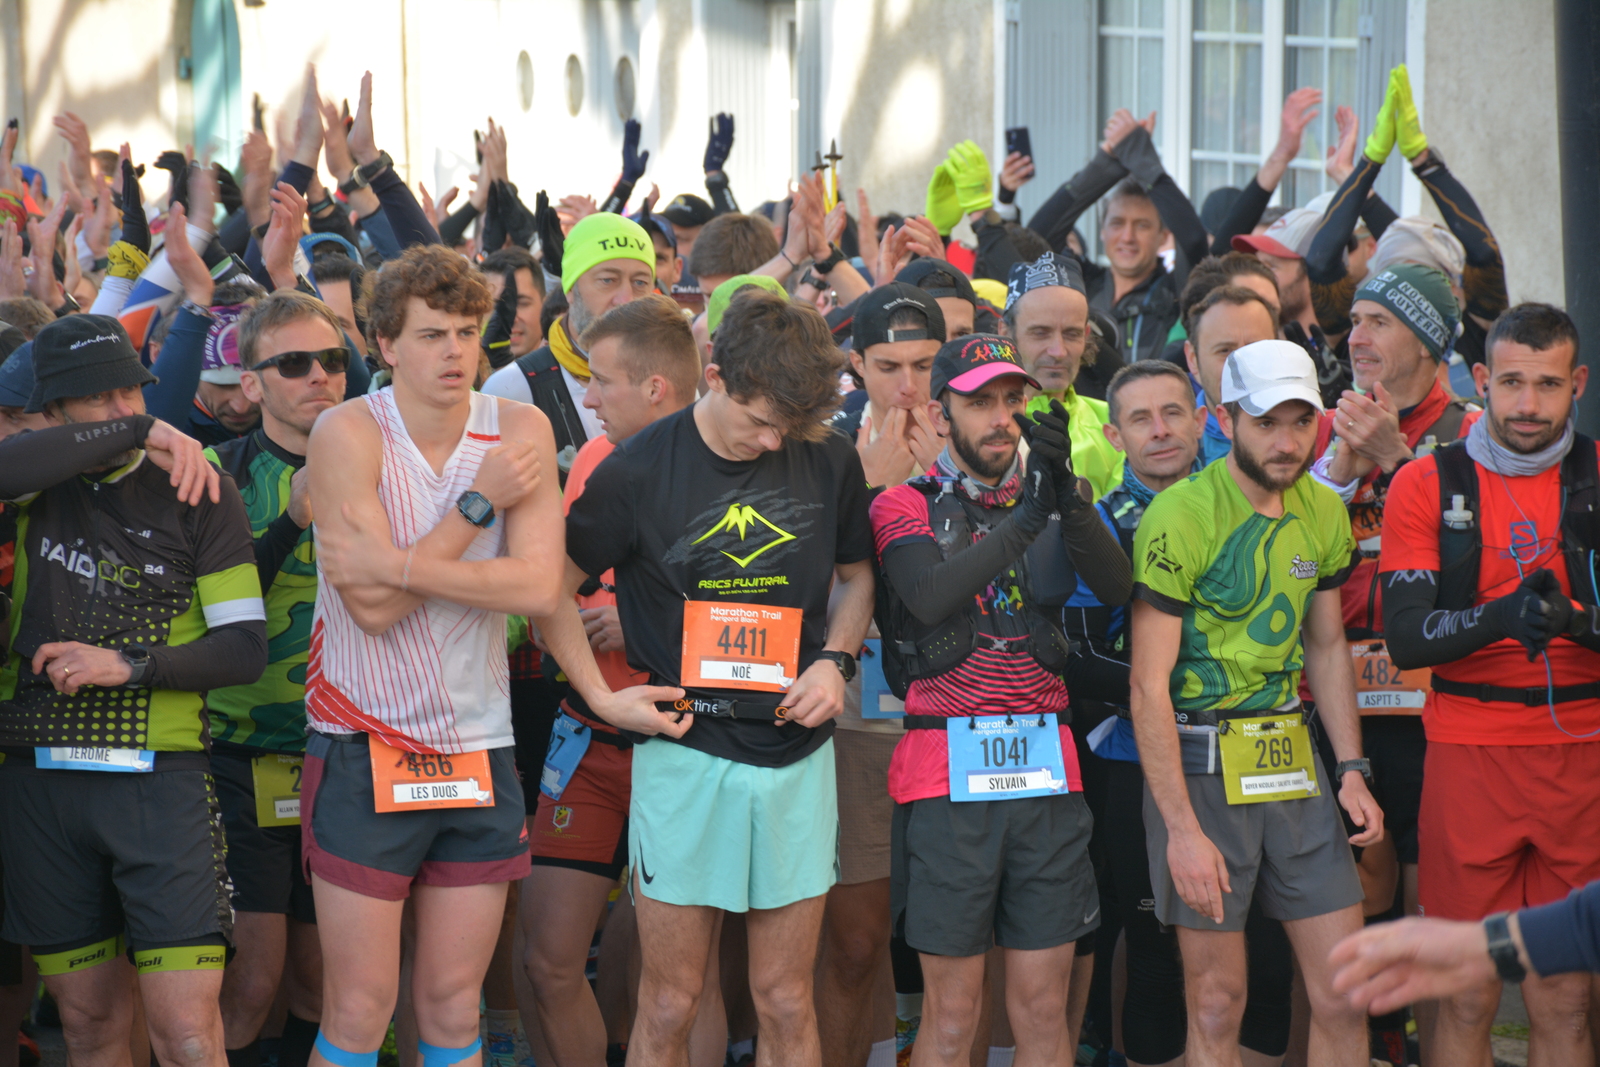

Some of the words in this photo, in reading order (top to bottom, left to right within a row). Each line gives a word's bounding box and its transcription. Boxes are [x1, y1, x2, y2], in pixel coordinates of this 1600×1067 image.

[144, 564, 165, 576] 24
[698, 579, 732, 589] ASICS
[732, 575, 790, 588] FUJITRAIL
[710, 606, 759, 617] Marathon
[761, 610, 782, 620] Trail
[717, 625, 767, 657] 4411
[731, 664, 752, 679] NOÉ
[1362, 658, 1403, 685] 482
[1364, 694, 1392, 706] ASPTT
[1395, 694, 1402, 706] 5
[980, 736, 1028, 767] 1041
[1255, 736, 1293, 769] 269
[989, 776, 1027, 791] SYLVAIN
[411, 785, 429, 800] LES
[68, 948, 105, 969] poli
